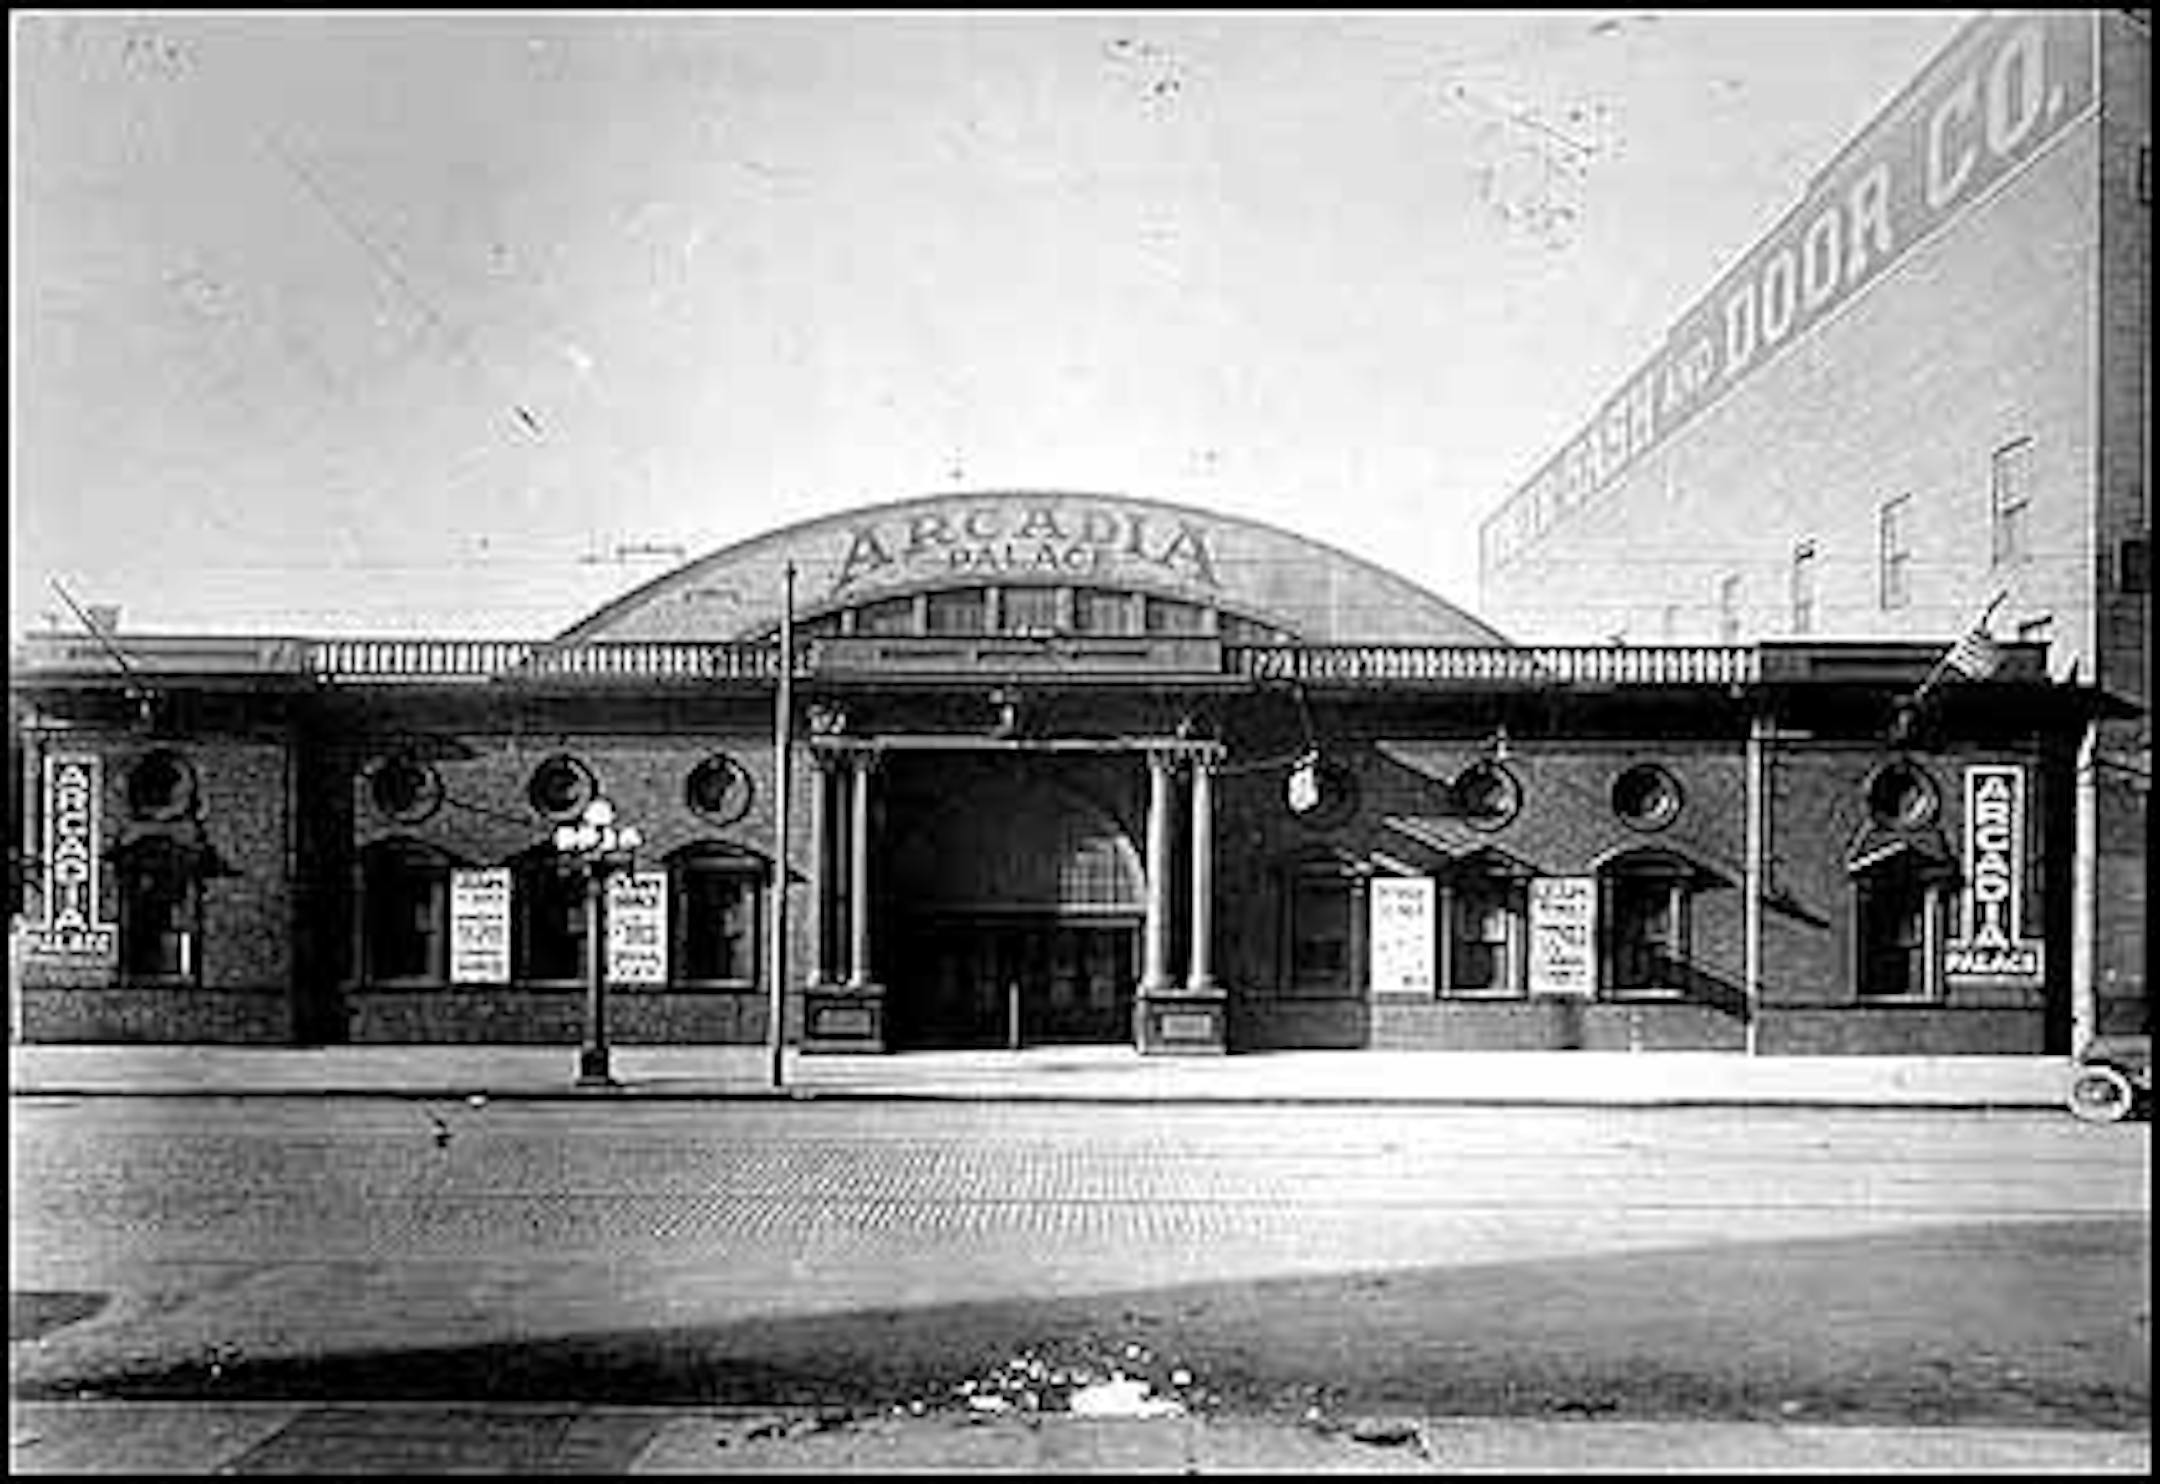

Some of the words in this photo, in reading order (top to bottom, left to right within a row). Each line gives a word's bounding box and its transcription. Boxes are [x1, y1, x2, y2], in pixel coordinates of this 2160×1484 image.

[1662, 338, 1715, 426] AND
[1724, 164, 1893, 380] DOOR
[1924, 24, 2066, 210] CO.
[832, 508, 1222, 598] ARCADIA
[949, 543, 1104, 573] PALACE
[53, 764, 89, 932] ARCADIA
[1974, 775, 2010, 950] ARCADIA
[1944, 950, 2035, 972] PALACE
